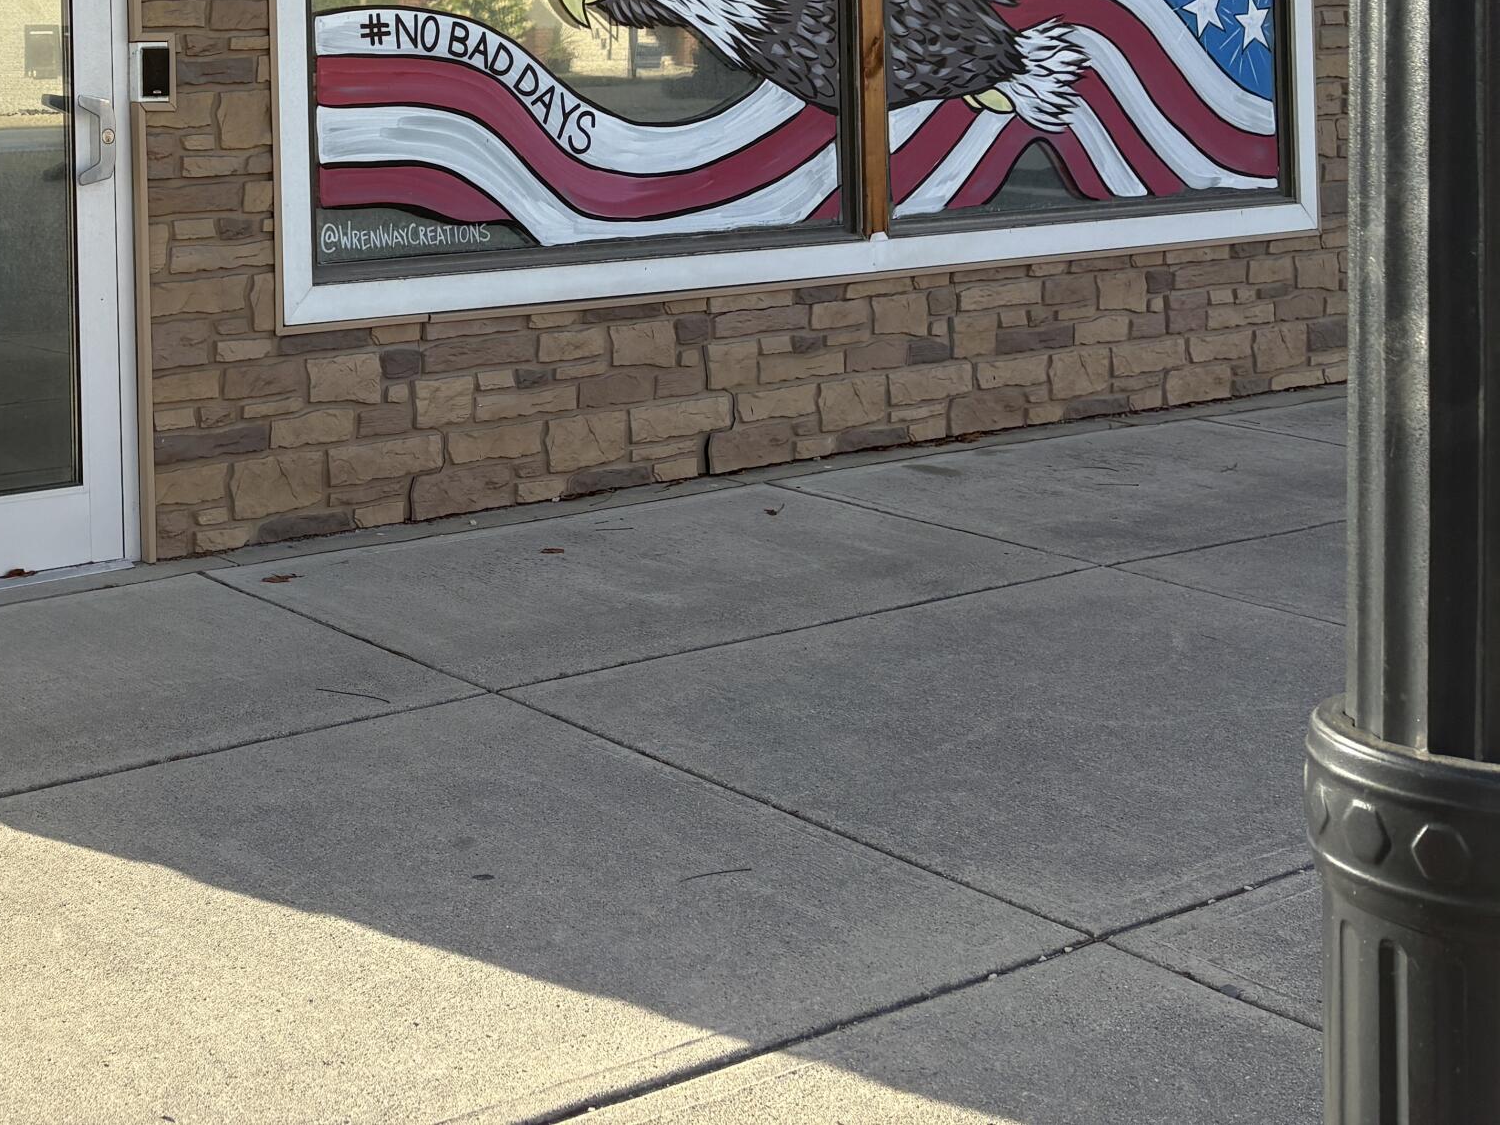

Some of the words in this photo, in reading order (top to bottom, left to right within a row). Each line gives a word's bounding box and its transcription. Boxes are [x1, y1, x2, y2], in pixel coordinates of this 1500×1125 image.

[360, 13, 440, 52] #NO
[447, 22, 514, 76] BAD
[514, 64, 596, 154] DAYS
